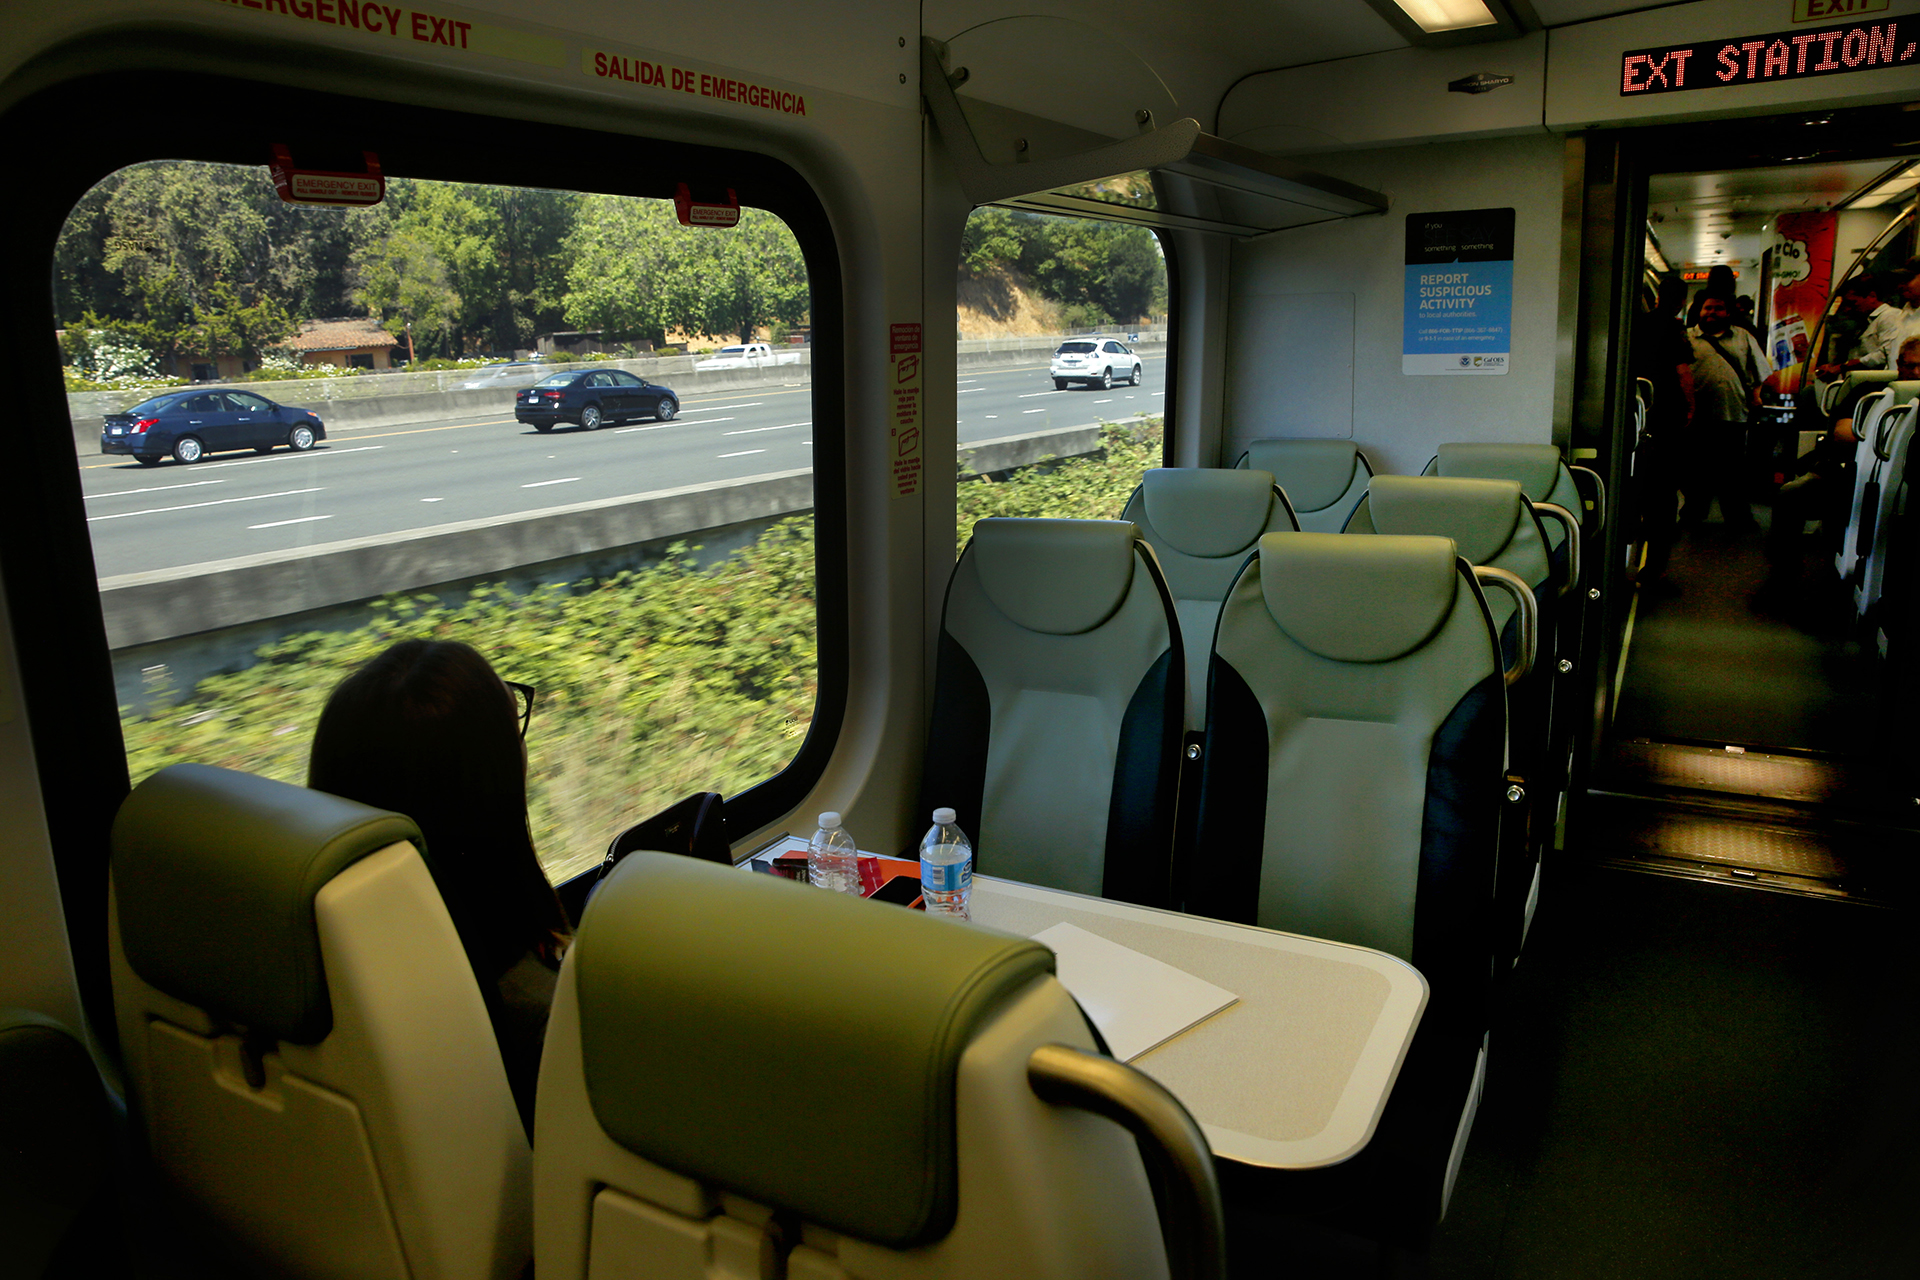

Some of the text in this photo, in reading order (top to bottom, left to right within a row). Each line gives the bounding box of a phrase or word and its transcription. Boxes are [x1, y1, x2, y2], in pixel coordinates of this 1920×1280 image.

[222, 0, 472, 49] GENCY EXIT
[1623, 23, 1917, 92] EXT STATION,
[595, 52, 806, 116] SALIDA DE EMERGENCIA
[296, 178, 376, 190] EMERGENCY EXIT
[1420, 274, 1469, 285] REPORT
[1420, 285, 1492, 298] SUSPICIOUS
[1419, 298, 1476, 310] ACTIVITY
